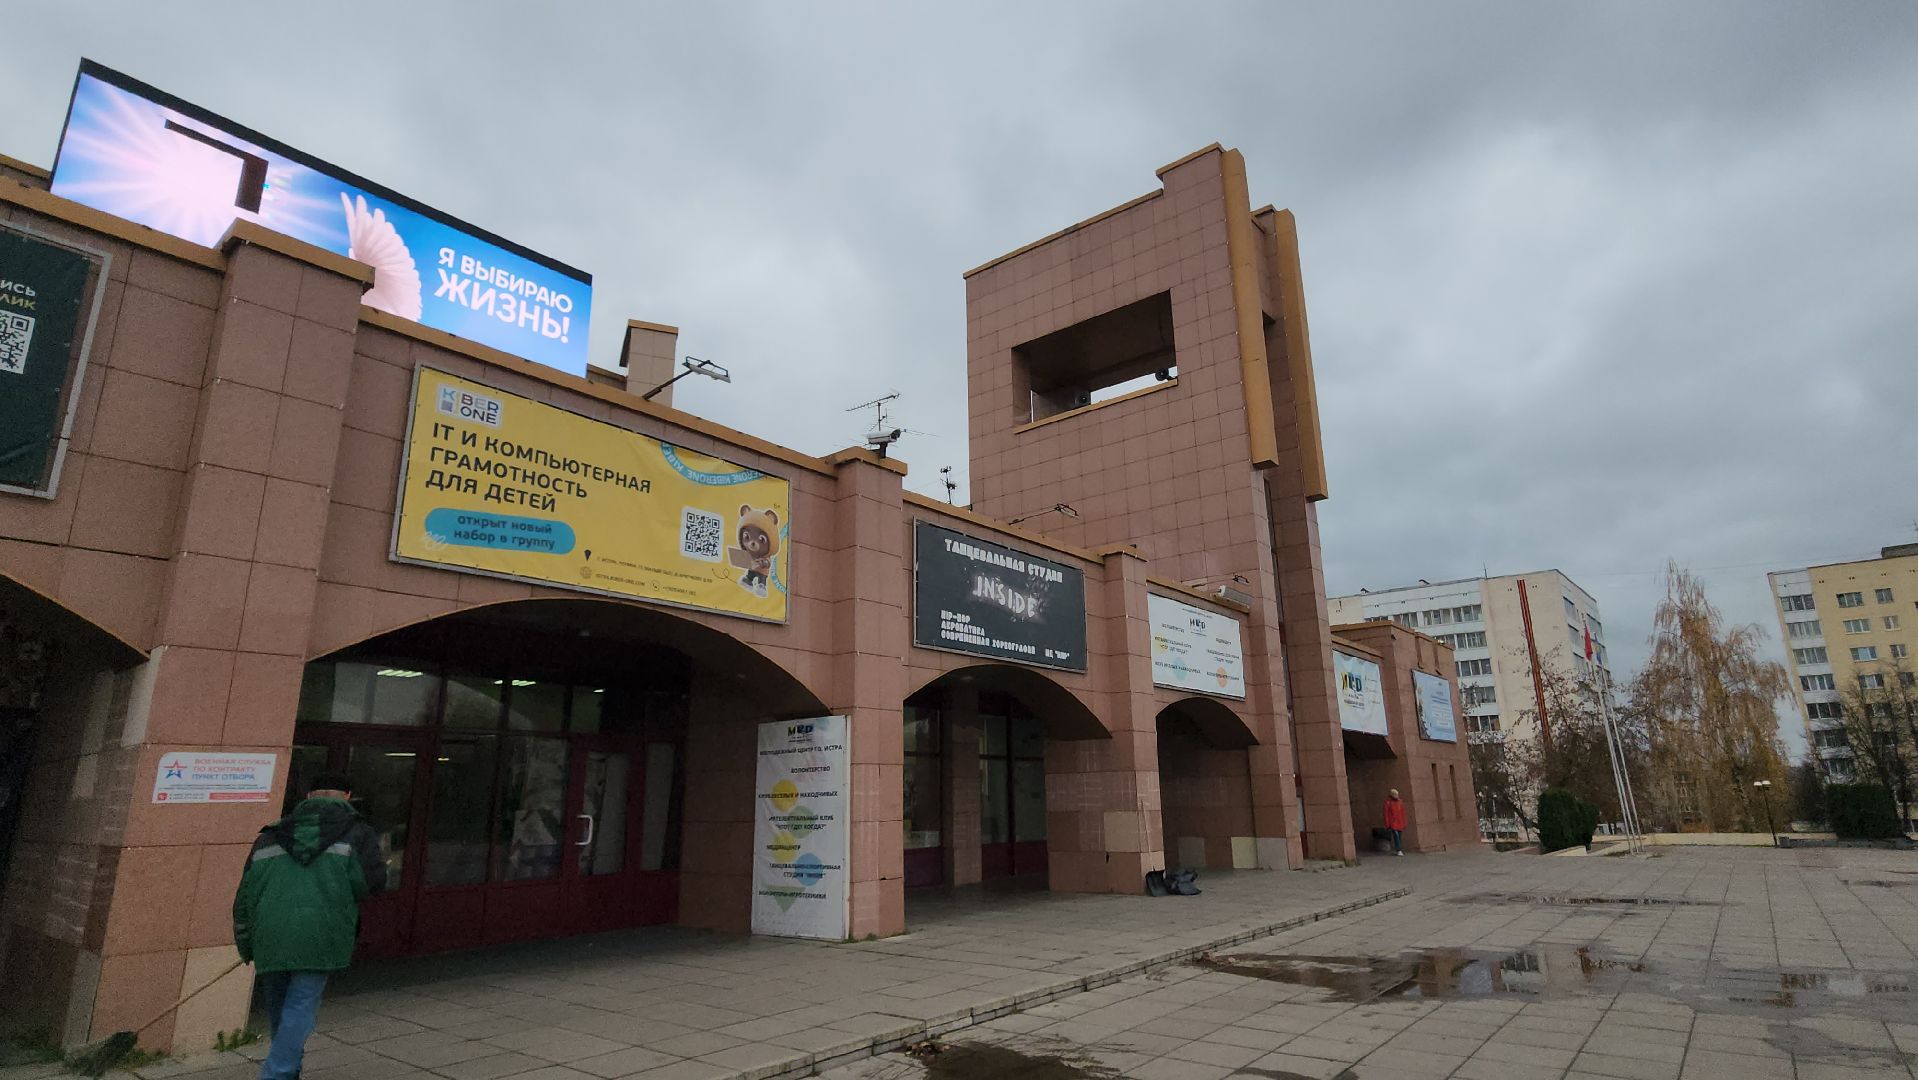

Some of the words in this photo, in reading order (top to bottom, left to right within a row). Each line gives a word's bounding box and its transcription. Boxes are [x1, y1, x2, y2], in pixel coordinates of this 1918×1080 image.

[438, 247, 456, 269] Я
[460, 254, 573, 313] ВЫБИРАЮ
[434, 267, 570, 343] ЖИЗНЬ!
[460, 406, 497, 424] ONE
[430, 446, 588, 498] ГРАМОТНОСТЬ
[461, 430, 477, 448] И
[484, 436, 651, 494] КОМПЬЮТЕРНАЯ
[425, 469, 478, 495] ДЛЯ
[484, 483, 556, 512] ДЕТЕЙ
[453, 529, 496, 544] набор
[500, 534, 507, 542] в
[512, 536, 556, 550] группу
[457, 515, 507, 530] открыт
[511, 519, 553, 534] новый
[944, 538, 1025, 573] ТАНЦЕВАЛЬНАЯ
[1028, 563, 1063, 583] СТУДИЯ
[940, 609, 971, 624] HIP-HOP
[940, 620, 985, 636] АКРОБАТИКА
